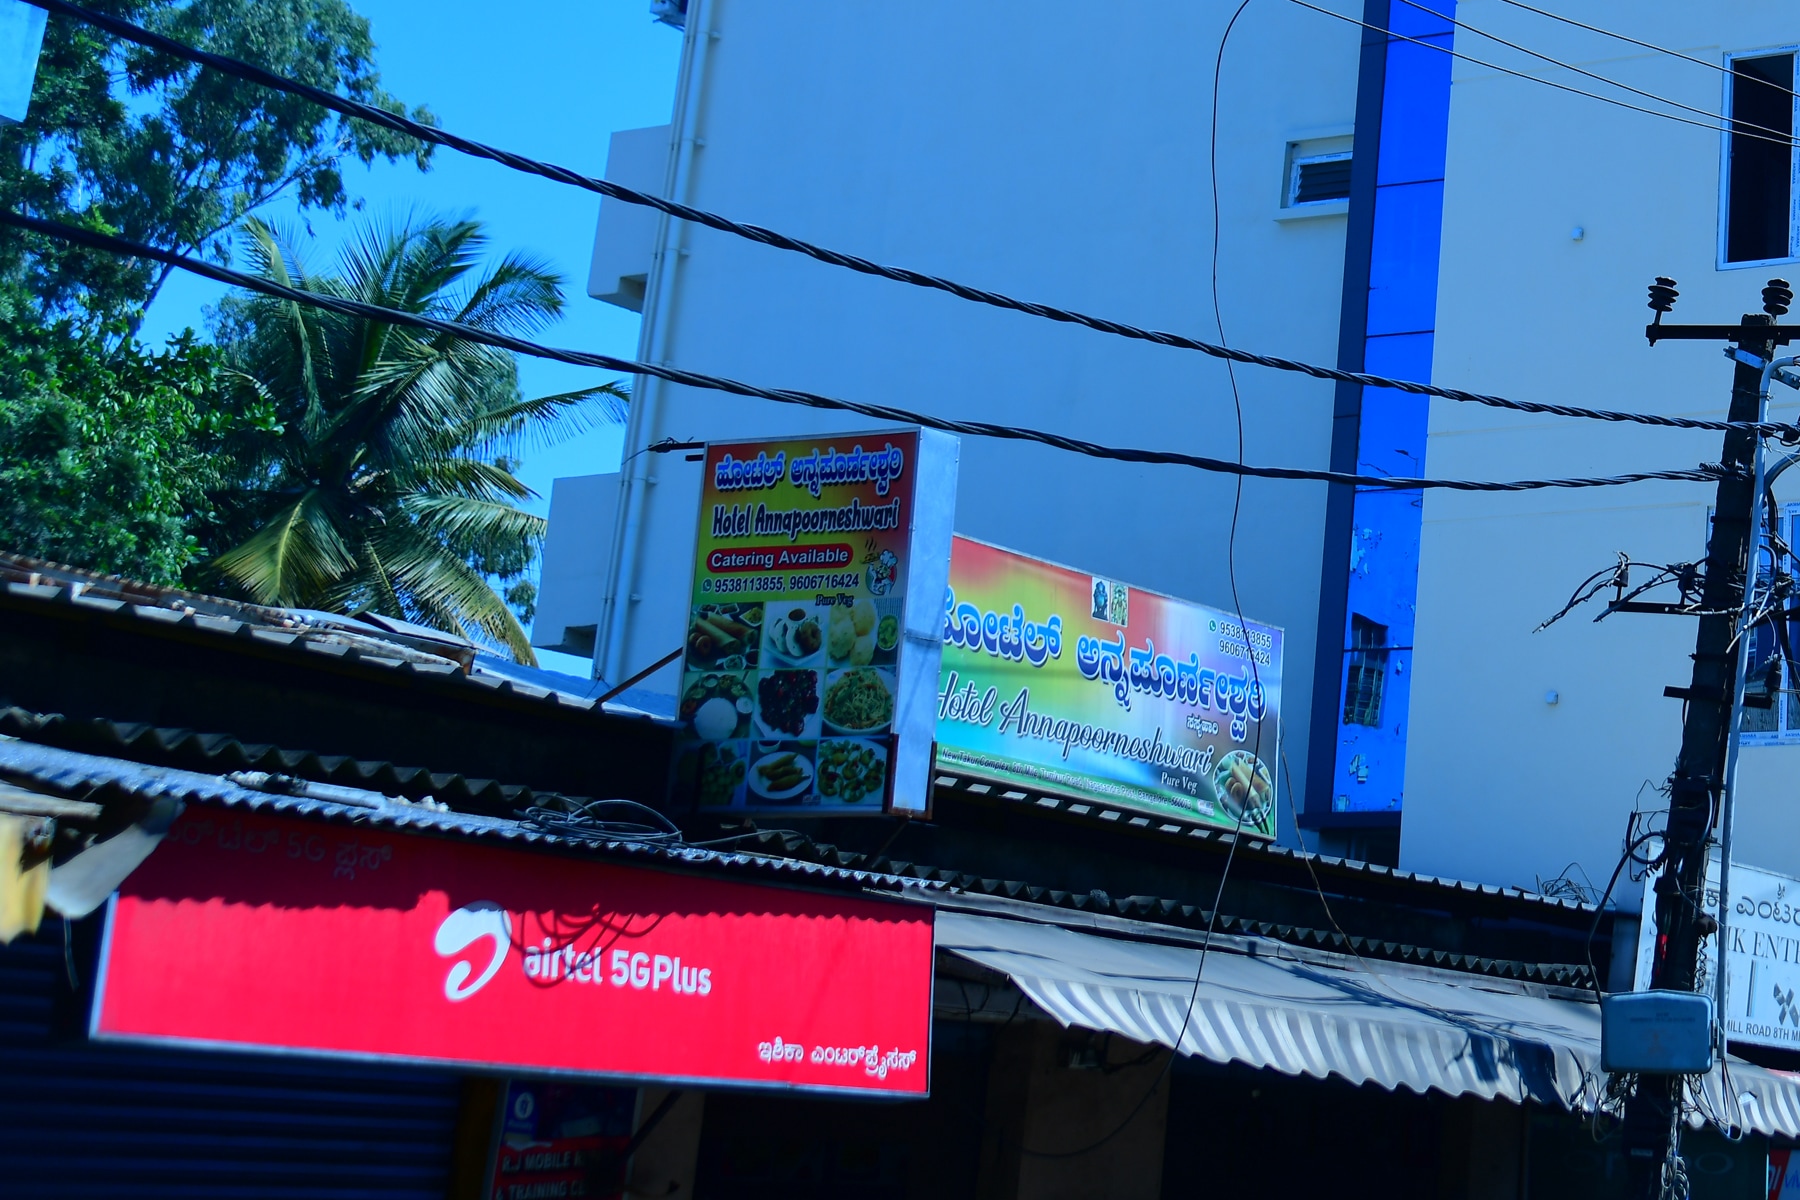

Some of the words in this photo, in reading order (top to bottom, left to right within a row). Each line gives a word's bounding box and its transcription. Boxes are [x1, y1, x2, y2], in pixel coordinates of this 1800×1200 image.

[715, 451, 785, 491] ಹೋಟೆಲ್
[712, 503, 752, 538] Hotel
[754, 497, 900, 541] Annapoorneshwari
[711, 553, 774, 569] Catering
[778, 548, 848, 565] Available
[714, 576, 786, 593] 9538113855,
[789, 573, 860, 591] 9606716424
[815, 594, 836, 607] Pure
[836, 593, 855, 608] Veg
[1220, 622, 1272, 649] 9538113855
[1219, 639, 1271, 667] 9606716424
[999, 687, 1213, 777] Annapoorneshwari
[942, 747, 957, 761] New
[1161, 771, 1181, 788] Pure
[1182, 775, 1198, 795] Veg
[523, 936, 604, 984] airtel
[1746, 1023, 1771, 1037] ROAD
[1773, 1026, 1790, 1041] 8TH
[524, 1150, 571, 1171] MOBILE
[508, 1179, 567, 1200] TRAINING
